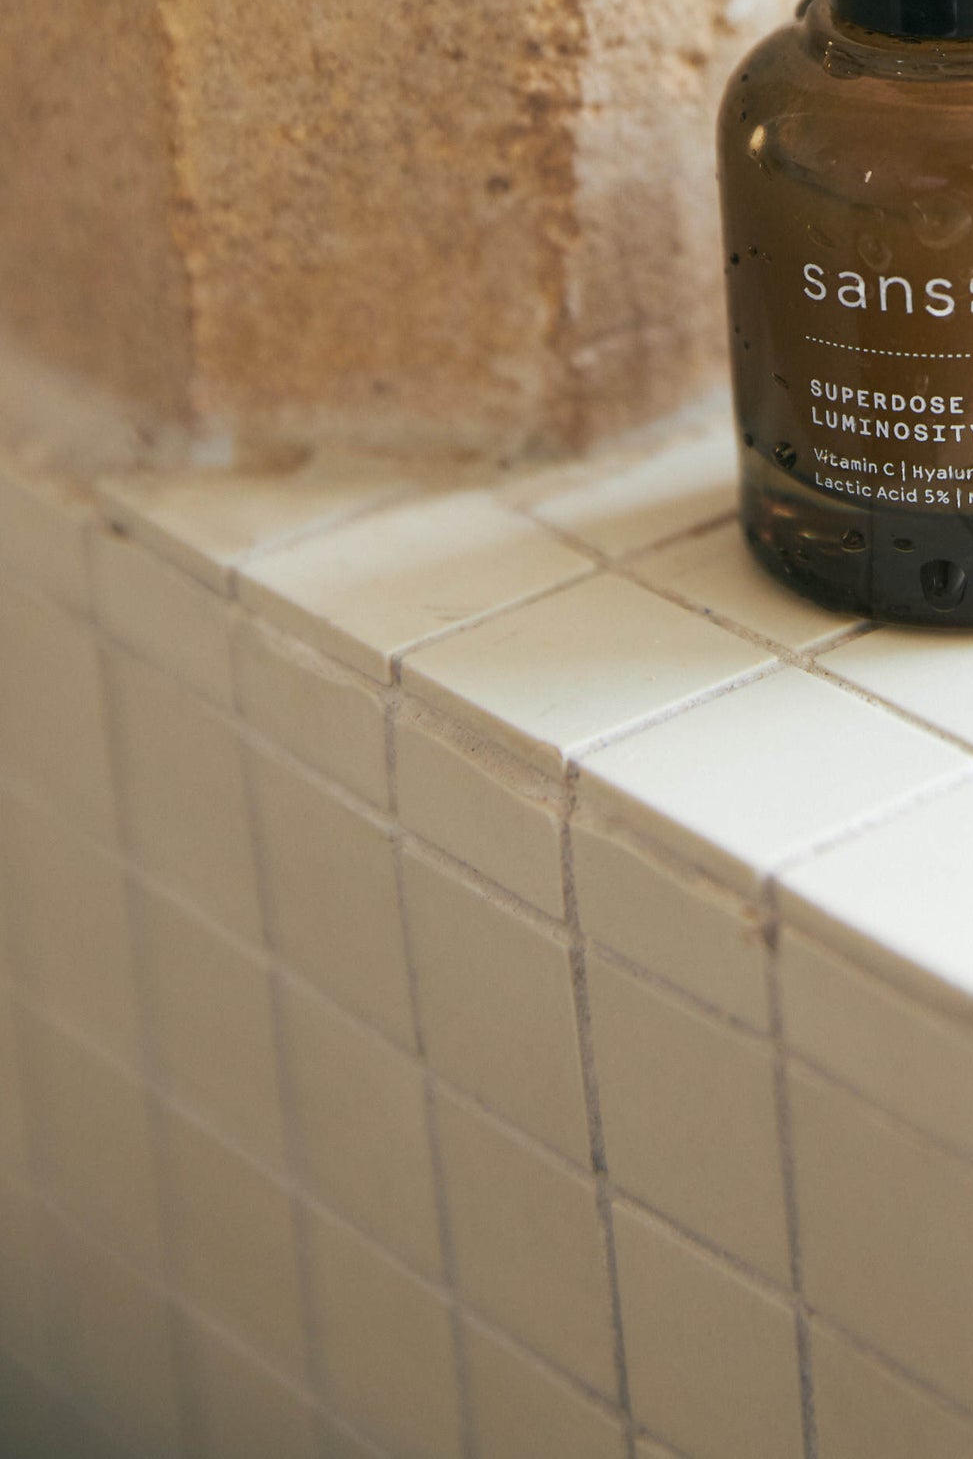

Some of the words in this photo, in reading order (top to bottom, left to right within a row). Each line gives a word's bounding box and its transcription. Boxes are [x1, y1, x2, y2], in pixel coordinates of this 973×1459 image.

[803, 263, 955, 317] sans
[810, 379, 964, 414] SUPERDOSE
[814, 448, 878, 474] Vitamin
[883, 462, 895, 477] C
[815, 473, 872, 498] Lactic
[876, 484, 917, 503] Acid
[925, 490, 950, 504] 5%
